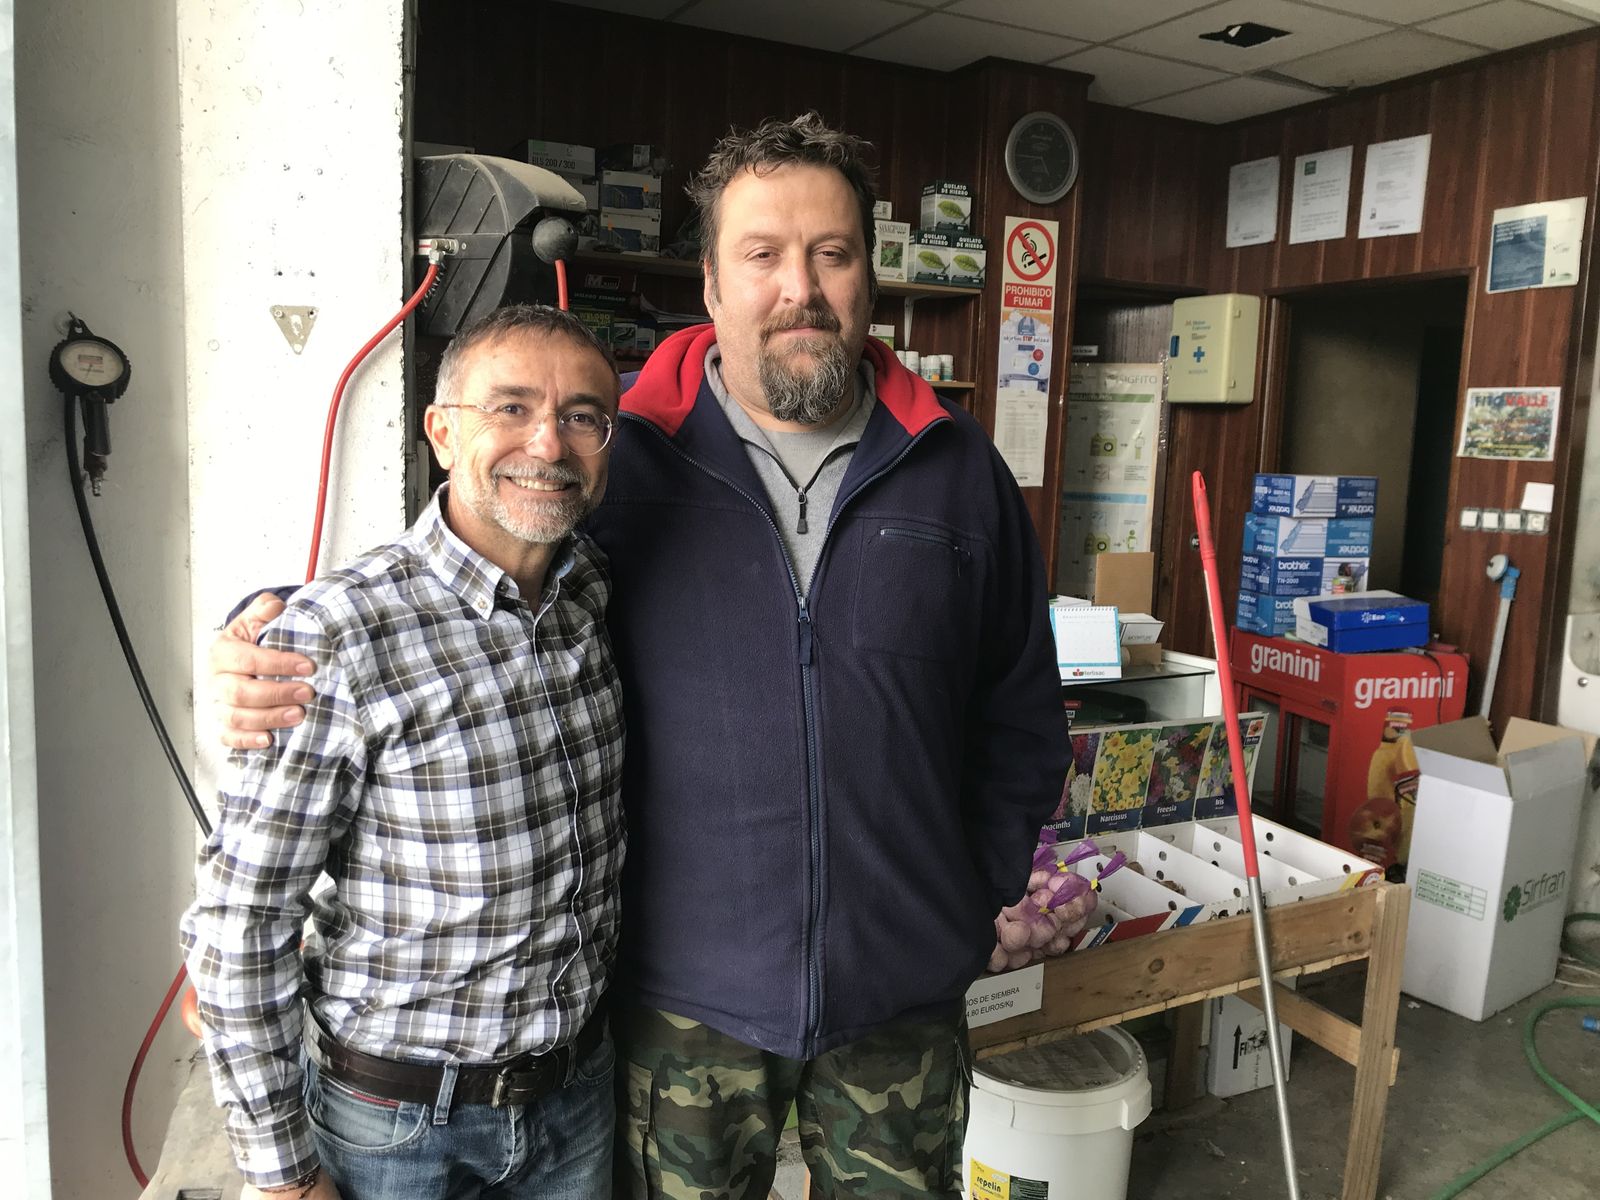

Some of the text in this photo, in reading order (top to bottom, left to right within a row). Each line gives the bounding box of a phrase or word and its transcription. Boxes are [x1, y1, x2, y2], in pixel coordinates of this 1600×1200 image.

[1005, 285, 1052, 298] PROHIBIDO
[1013, 296, 1044, 308] FUMAR
[1278, 560, 1310, 570] brother
[1251, 643, 1320, 682] granini
[1354, 671, 1455, 709] granini
[1215, 798, 1224, 806] Iris
[1156, 804, 1177, 814] Freesia
[1100, 813, 1128, 823] Narcissus
[1521, 870, 1566, 906] Sirfran
[979, 995, 990, 1003] DE
[991, 987, 1020, 1000] SIEMBRA
[980, 1001, 1014, 1014] EUROS/Kg
[976, 1176, 1001, 1193] repelin
